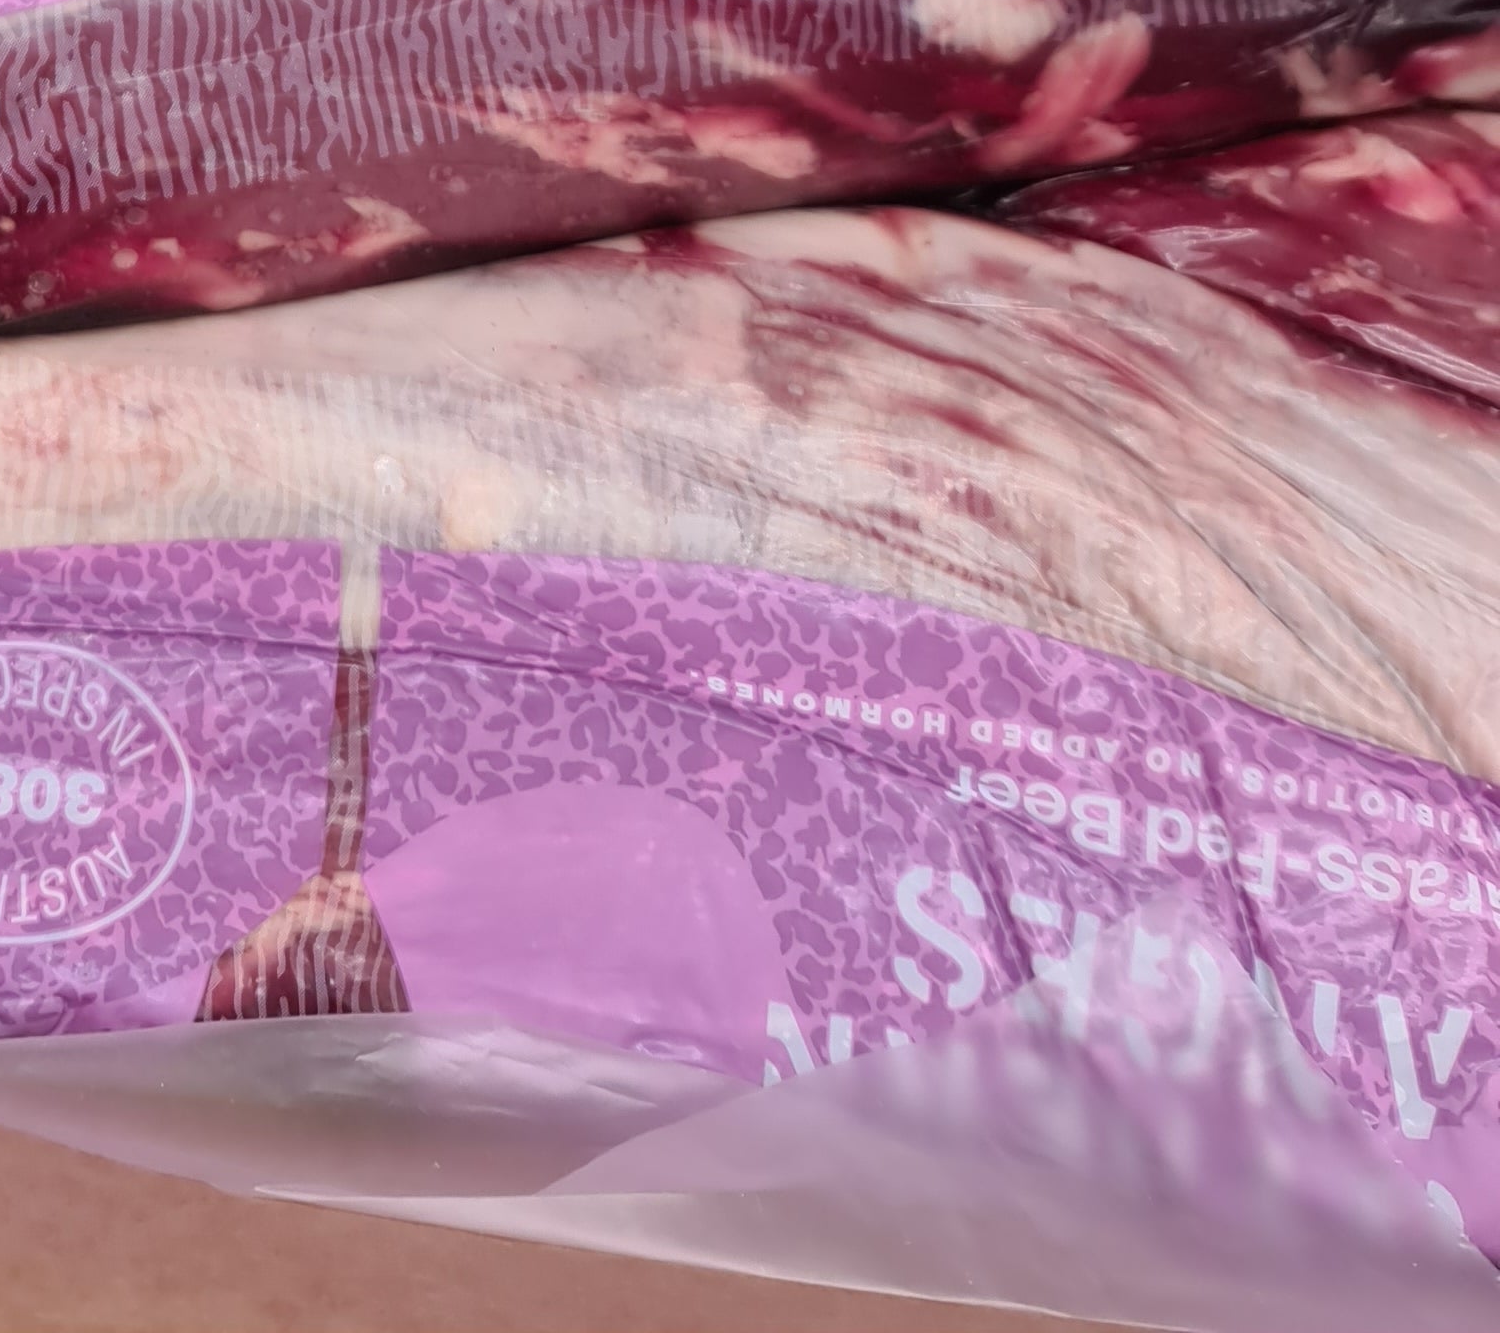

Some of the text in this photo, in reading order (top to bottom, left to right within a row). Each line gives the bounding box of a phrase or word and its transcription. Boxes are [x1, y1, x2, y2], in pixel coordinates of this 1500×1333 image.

[690, 671, 947, 735] HORMONES.
[969, 719, 1121, 763] ADDED
[1145, 747, 1201, 777] NO
[943, 765, 1122, 858] Beef
